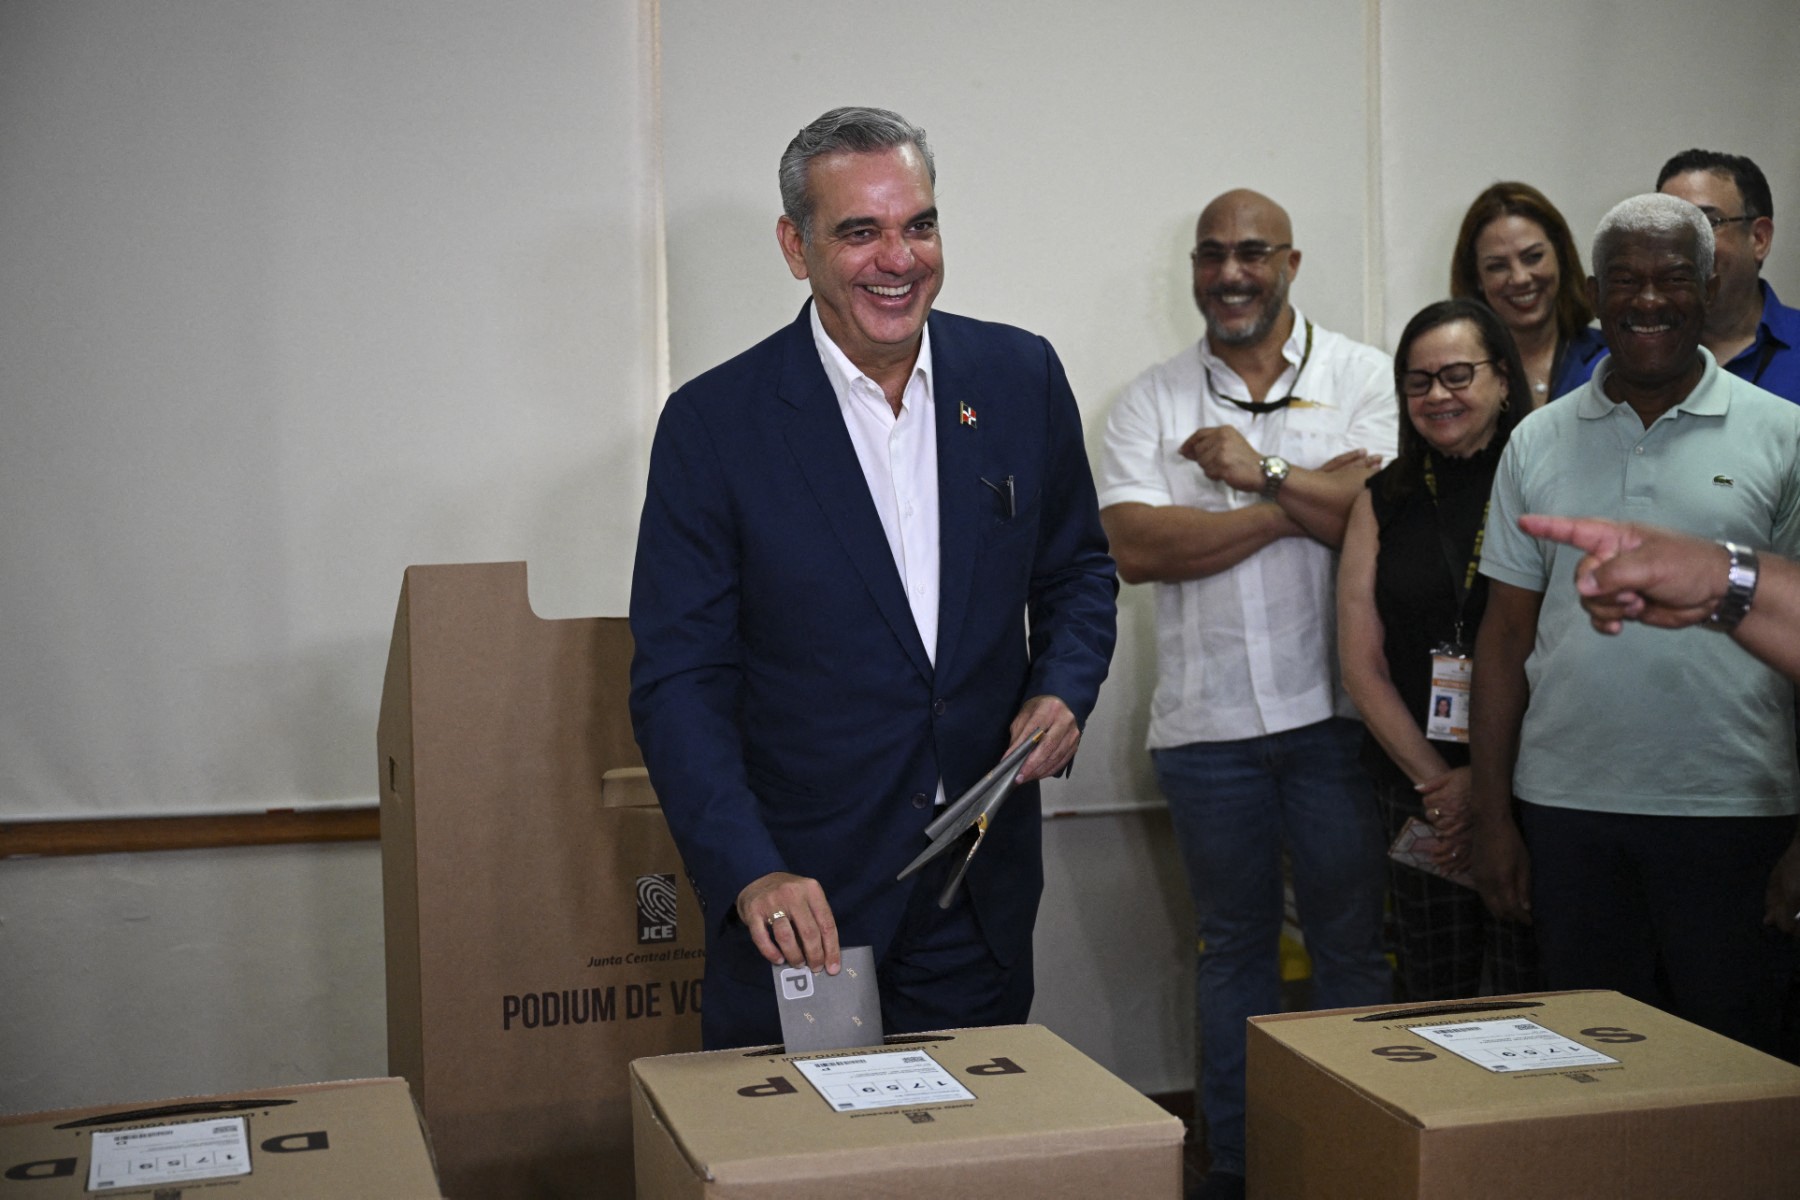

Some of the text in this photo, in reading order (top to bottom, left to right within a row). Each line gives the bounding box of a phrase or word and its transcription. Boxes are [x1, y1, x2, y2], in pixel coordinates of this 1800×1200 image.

[641, 925, 674, 940] JCE
[587, 956, 622, 968] Junta
[626, 949, 671, 964] Central
[786, 974, 808, 992] P
[503, 986, 616, 1031] PODIUM
[626, 982, 662, 1020] DE
[1579, 1026, 1647, 1043] S
[1372, 1045, 1437, 1063] S
[966, 1056, 1027, 1076] P
[737, 1076, 799, 1097] P
[260, 1130, 329, 1153] D
[5, 1157, 78, 1181] D
